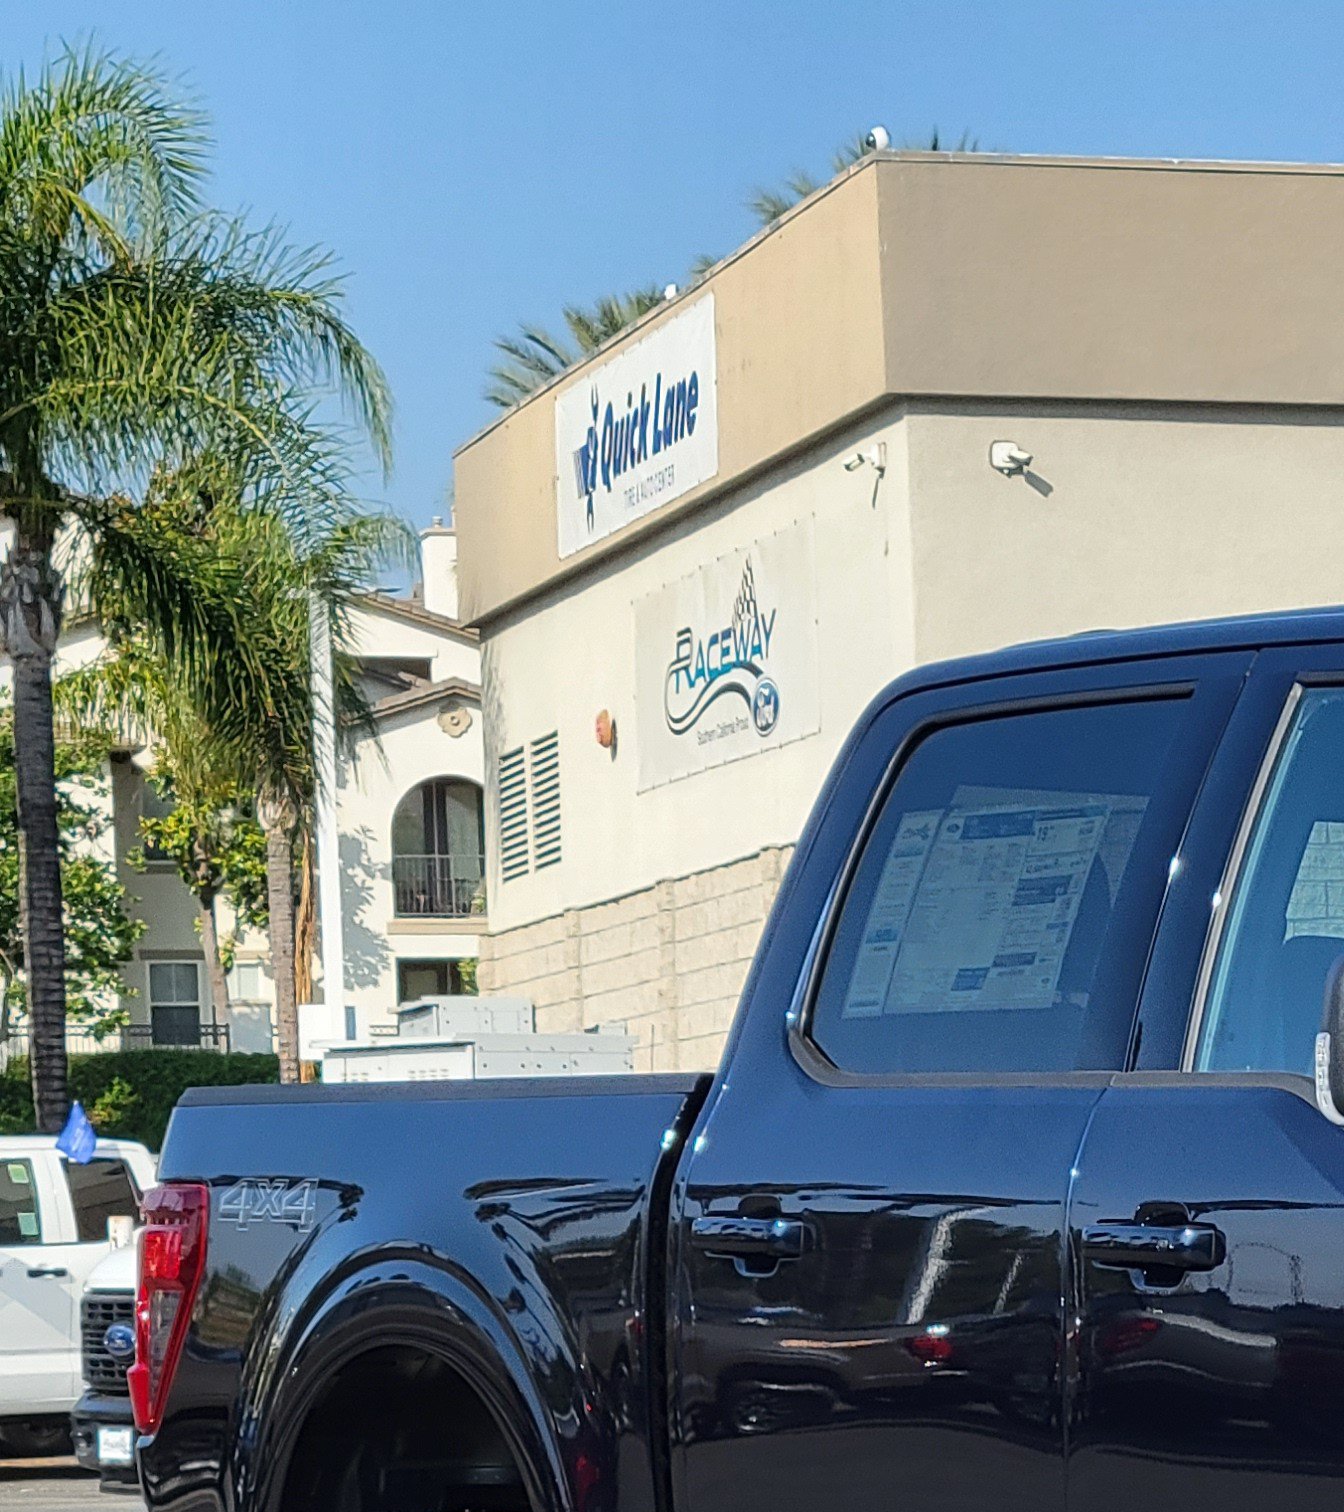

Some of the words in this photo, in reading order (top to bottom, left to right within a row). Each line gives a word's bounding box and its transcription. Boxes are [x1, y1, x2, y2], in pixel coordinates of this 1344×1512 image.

[601, 382, 650, 494] Quick
[652, 370, 699, 456] Lane
[675, 607, 777, 694] RACEWAY
